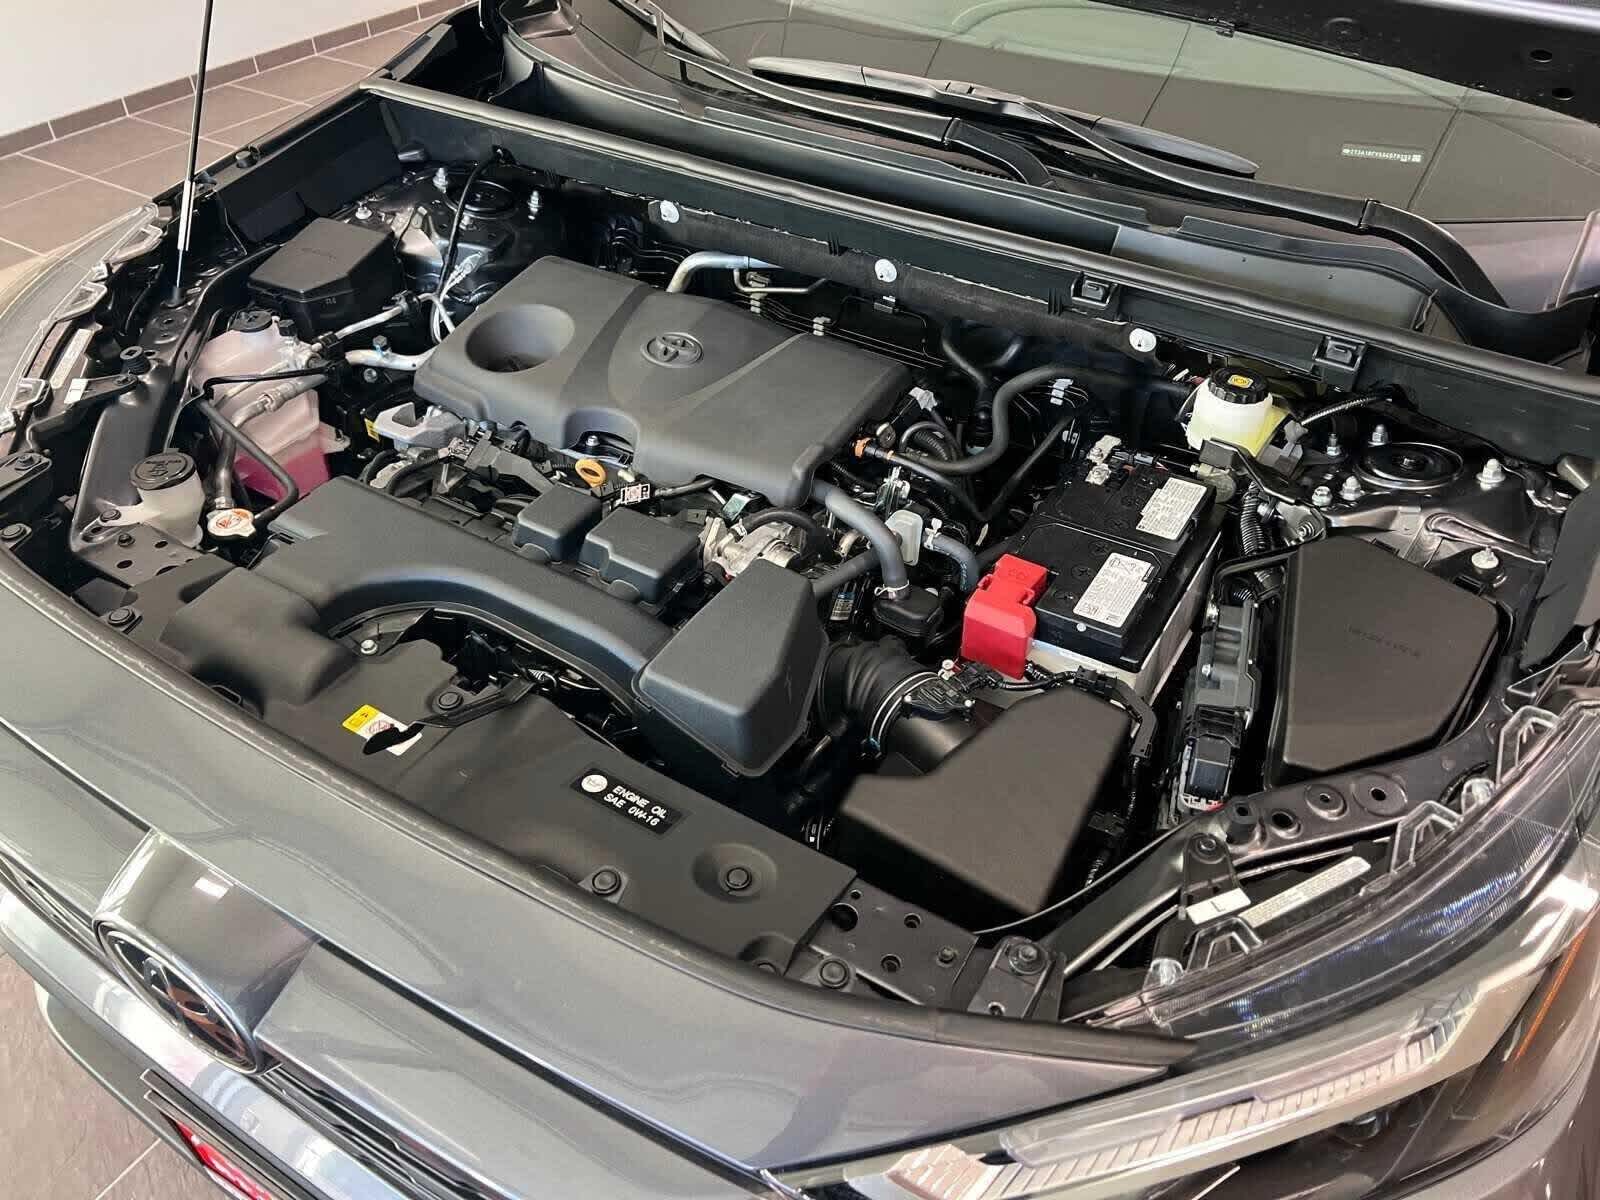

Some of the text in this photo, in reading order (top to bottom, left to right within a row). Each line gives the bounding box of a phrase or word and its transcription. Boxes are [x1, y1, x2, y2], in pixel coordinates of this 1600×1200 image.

[603, 793, 660, 826] SAE 0W-16
[612, 785, 667, 819] ENGINE OIL
